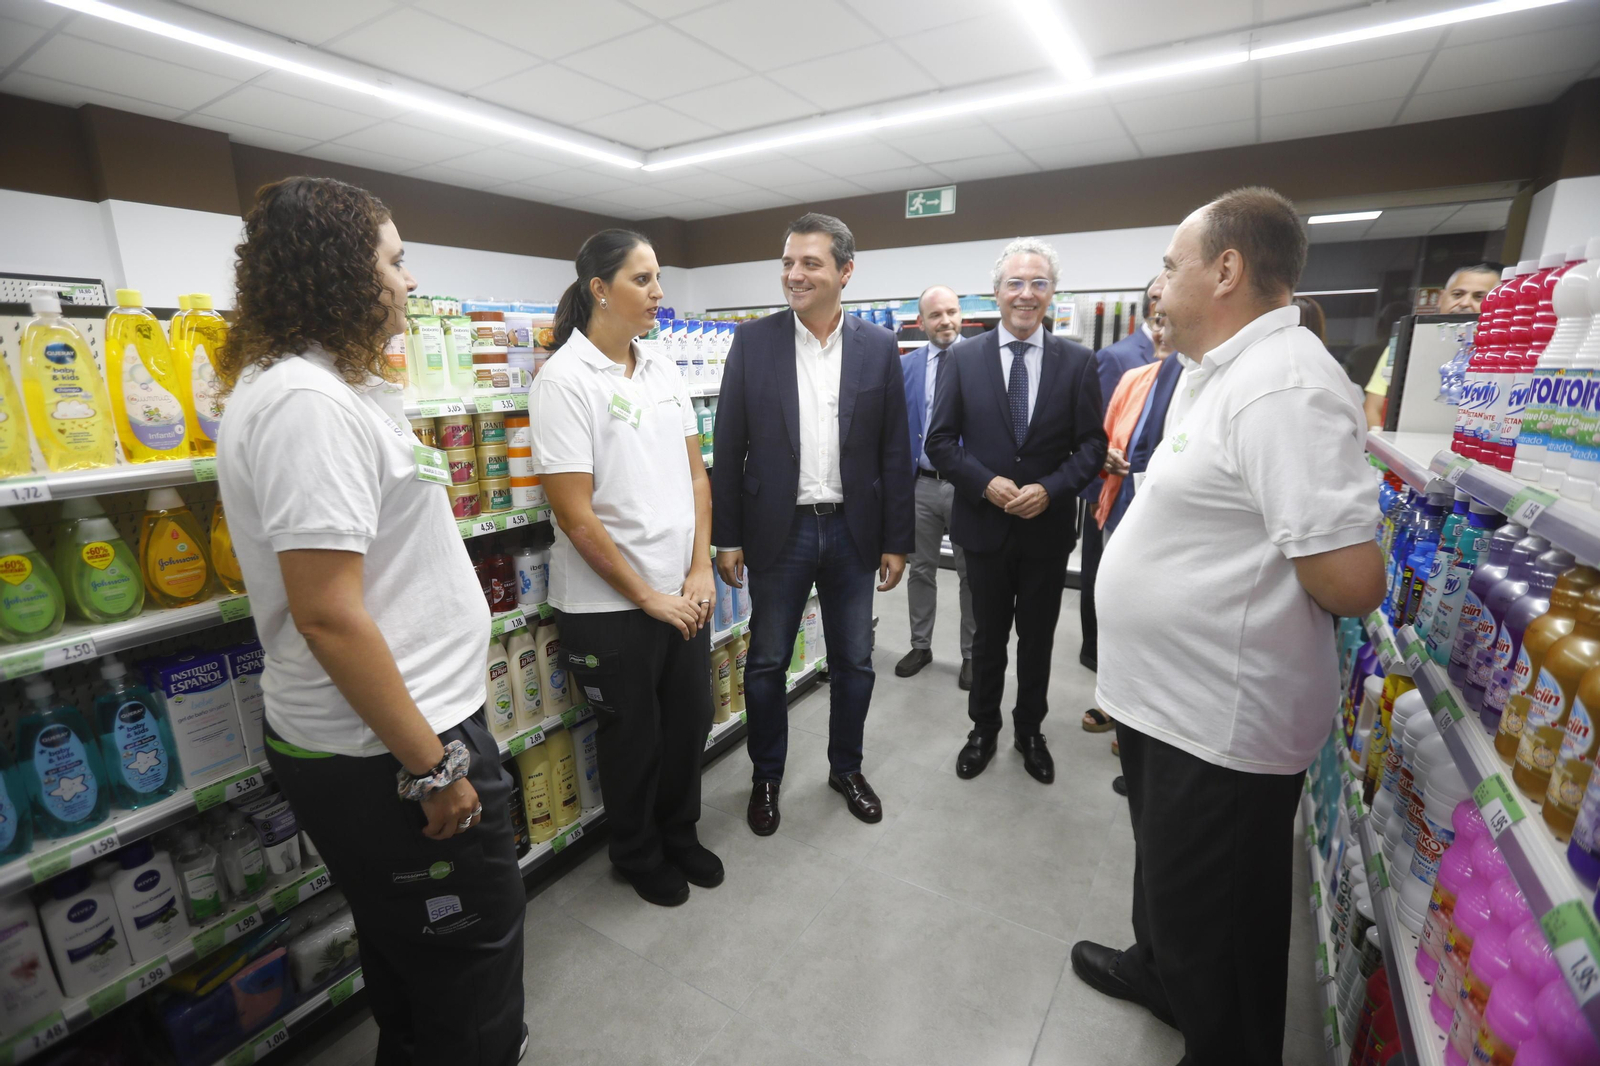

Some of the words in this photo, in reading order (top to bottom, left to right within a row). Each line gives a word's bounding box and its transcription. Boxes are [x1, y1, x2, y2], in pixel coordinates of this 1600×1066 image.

[148, 432, 176, 440] Infantil
[158, 554, 200, 572] Johnson's
[91, 576, 130, 592] Johnson's
[62, 643, 91, 660] 2,50
[170, 662, 218, 682] INSTITUTO
[170, 670, 224, 694] ESPAÑOL
[126, 722, 146, 732] baby
[134, 727, 149, 736] kids
[48, 747, 70, 757] baby
[56, 752, 74, 762] kids
[236, 776, 256, 793] 5,30
[1490, 808, 1508, 833] 1,95
[90, 836, 116, 855] 1,59
[137, 875, 158, 888] NIVEA
[310, 876, 328, 892] 1,99
[70, 904, 95, 918] NIVEA
[430, 904, 460, 920] SEPE
[235, 915, 256, 934] 1,99
[138, 968, 164, 988] 2,99
[266, 1030, 285, 1049] 1,00
